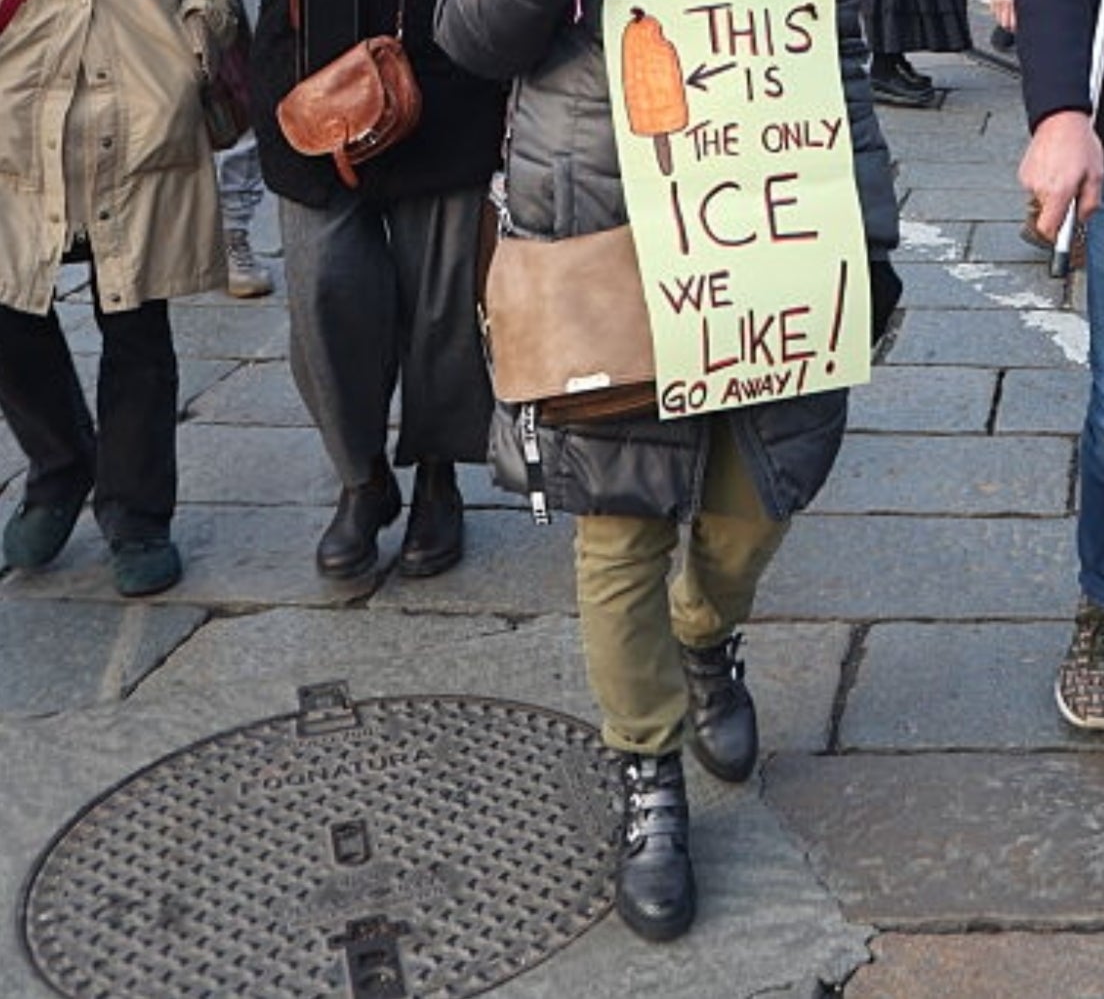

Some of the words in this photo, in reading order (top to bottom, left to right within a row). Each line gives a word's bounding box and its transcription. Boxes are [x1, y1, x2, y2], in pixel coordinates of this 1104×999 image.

[684, 3, 819, 57] THIS
[745, 67, 784, 101] IS
[684, 119, 739, 161] THE
[761, 117, 842, 153] ONLY
[670, 172, 819, 255] ICE
[658, 270, 735, 314] WE
[661, 379, 708, 414] GO
[721, 360, 809, 404] AWAY!
